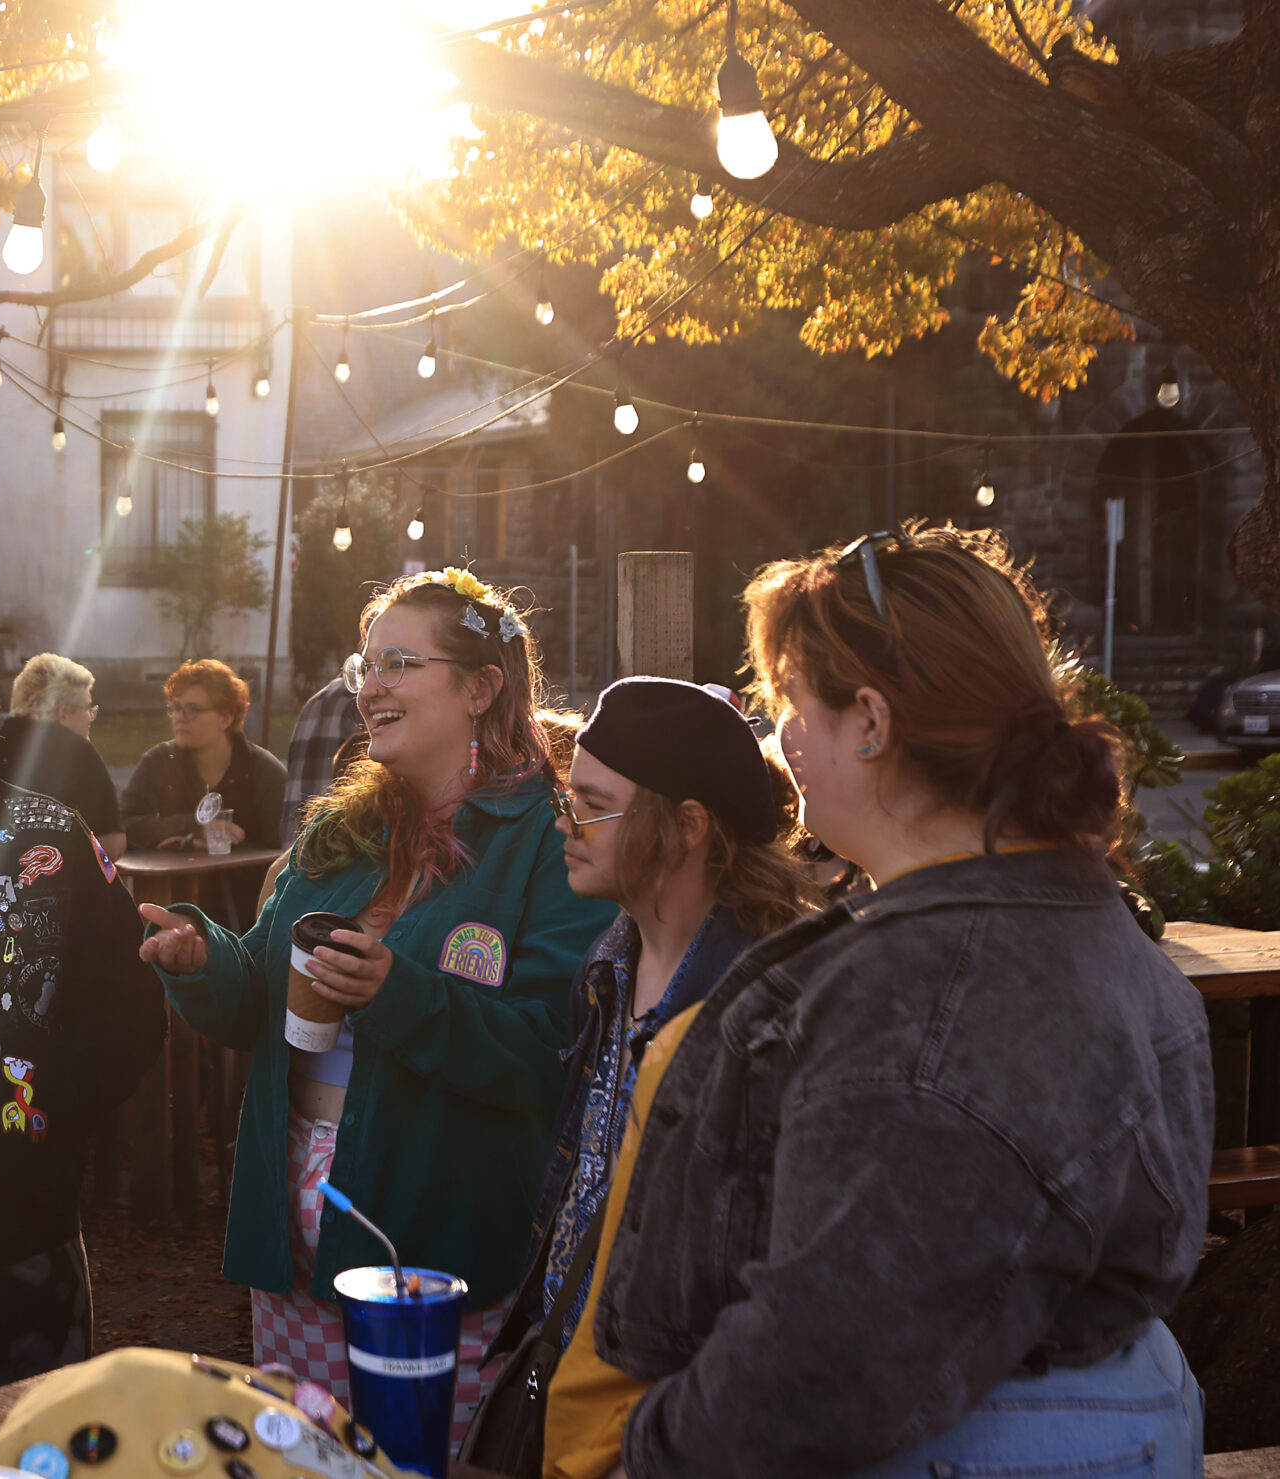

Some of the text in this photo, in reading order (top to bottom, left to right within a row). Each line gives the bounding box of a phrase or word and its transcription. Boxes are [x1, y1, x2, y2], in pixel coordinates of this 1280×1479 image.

[22, 909, 50, 928] STAY
[451, 928, 476, 950] ALWAYS
[446, 949, 499, 981] FRIENDS
